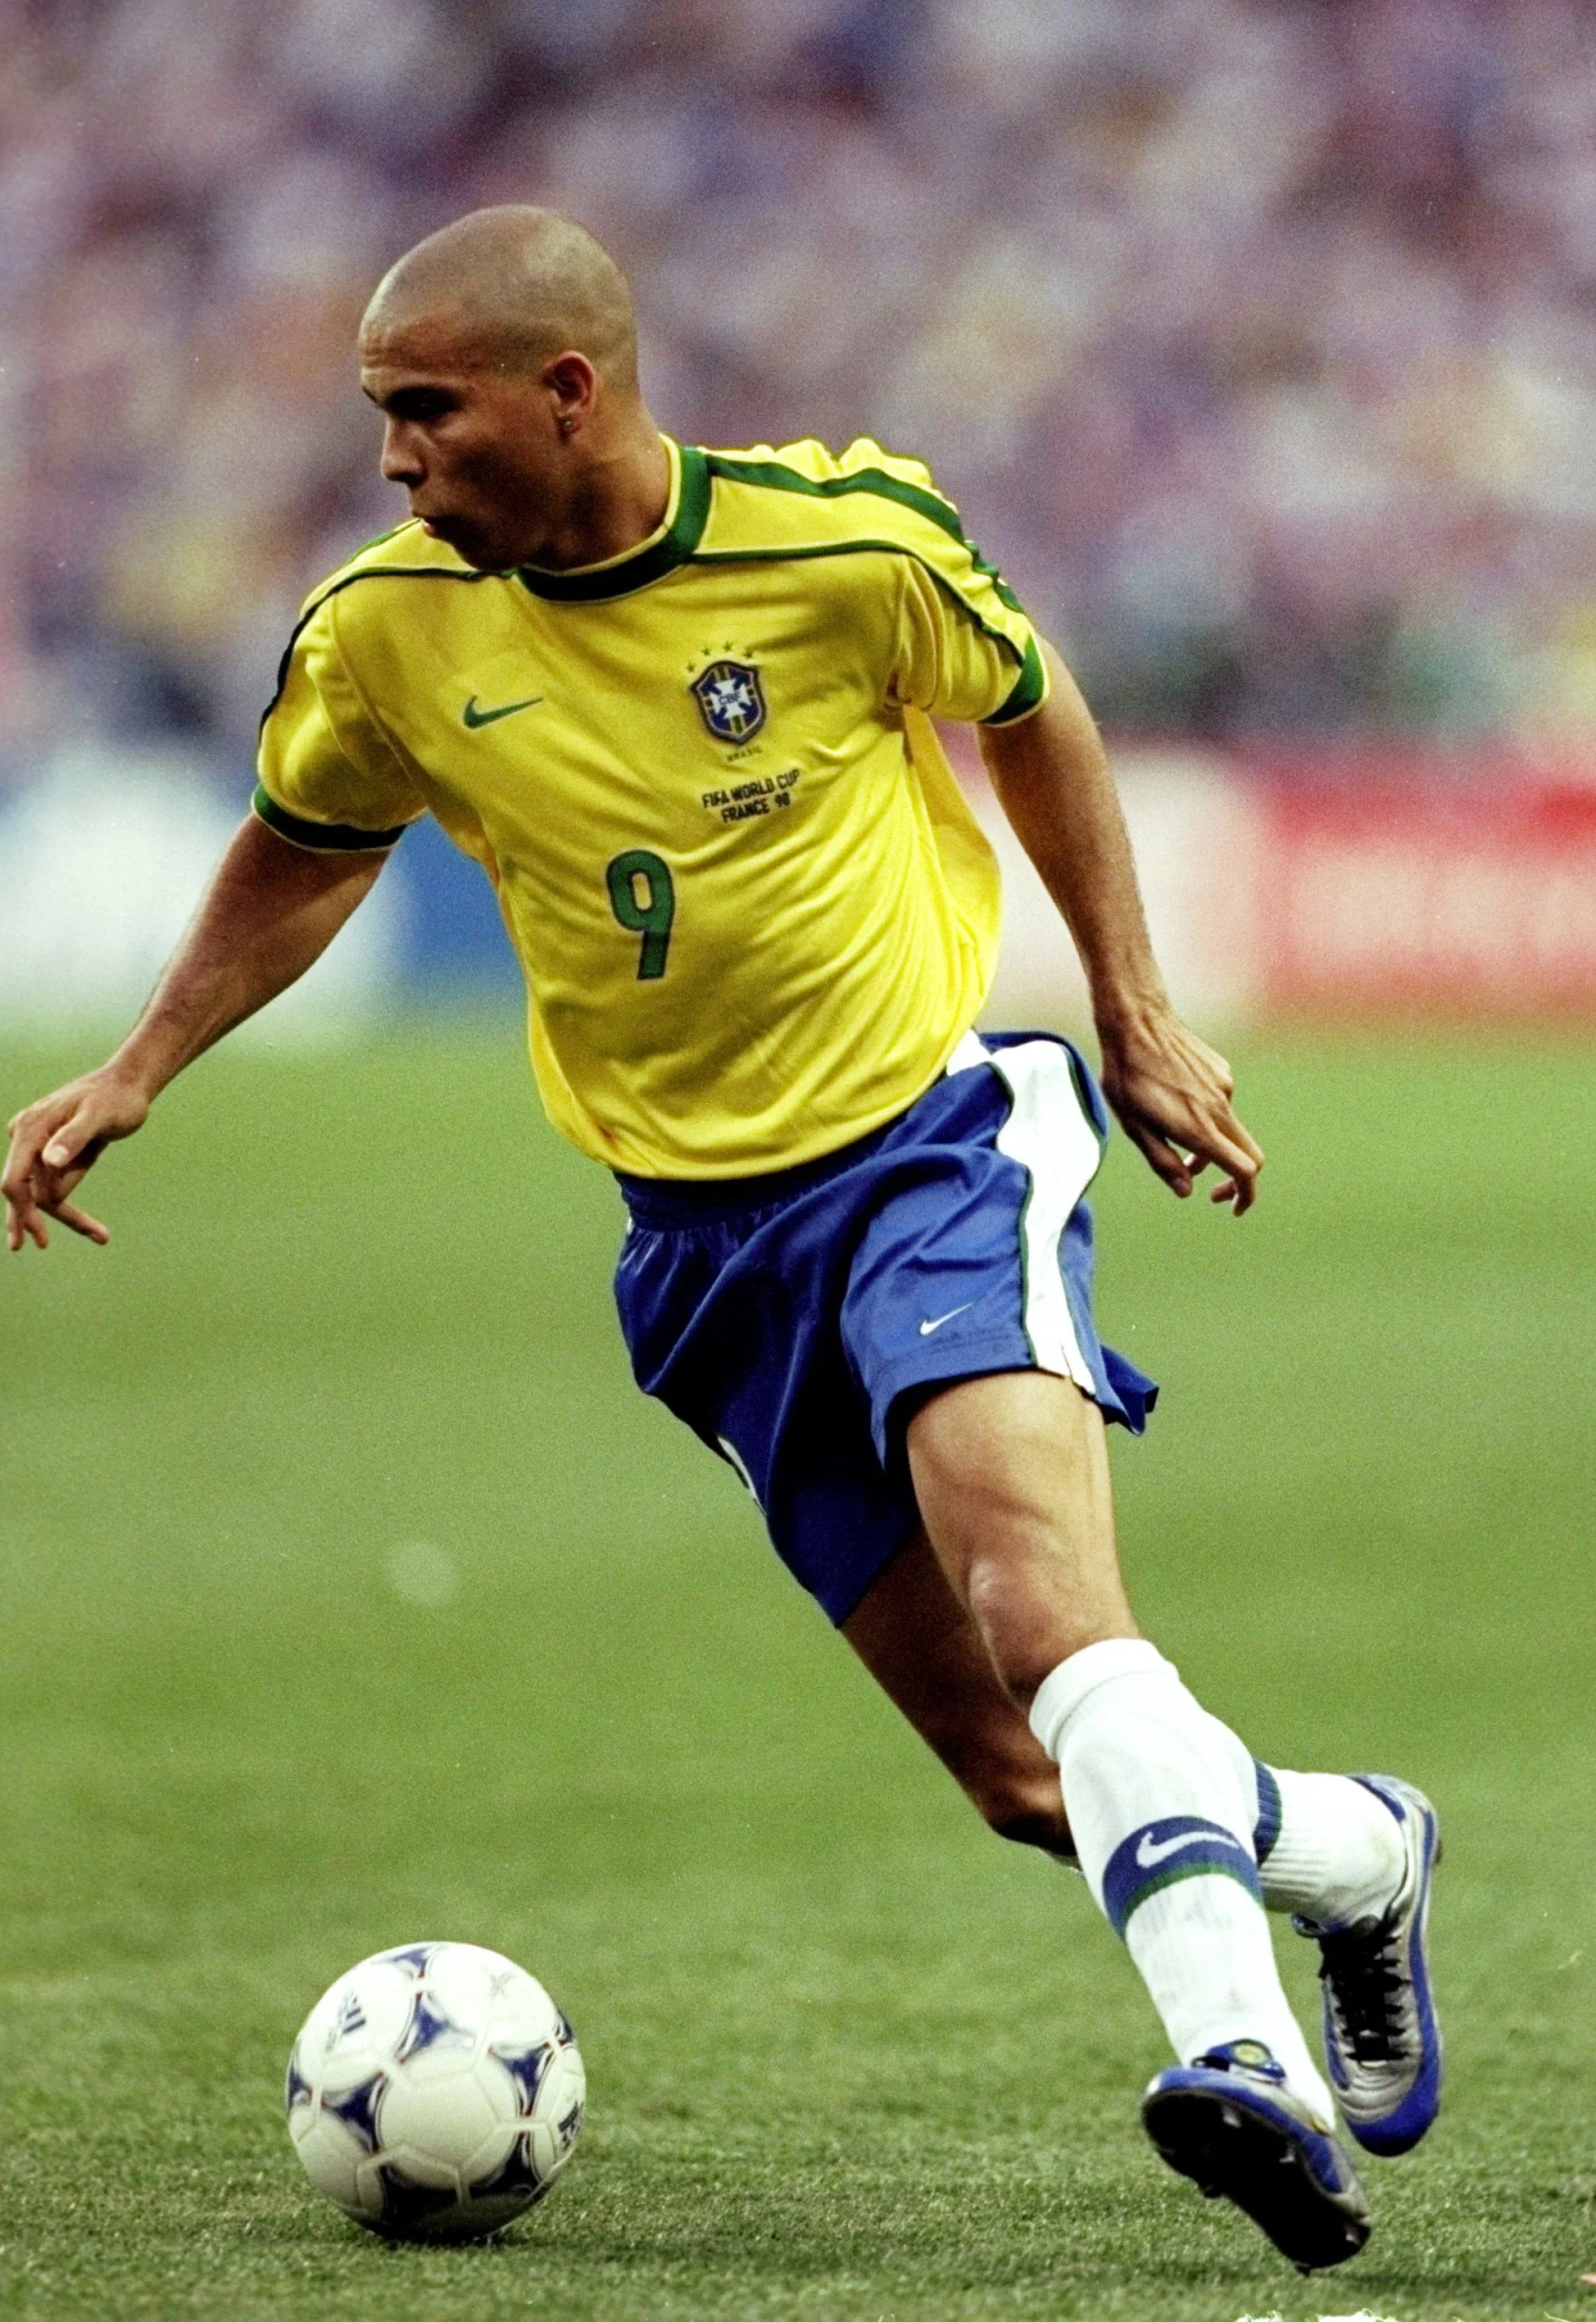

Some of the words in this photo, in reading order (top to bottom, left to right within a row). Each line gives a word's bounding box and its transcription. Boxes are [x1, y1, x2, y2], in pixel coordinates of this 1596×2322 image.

[718, 692, 741, 706] CBF
[702, 790, 730, 808] FIFA
[730, 777, 775, 801] WORLD
[776, 768, 800, 790] CUP
[721, 798, 770, 824] FRANCE
[774, 791, 791, 808] 98
[606, 849, 675, 981] 9
